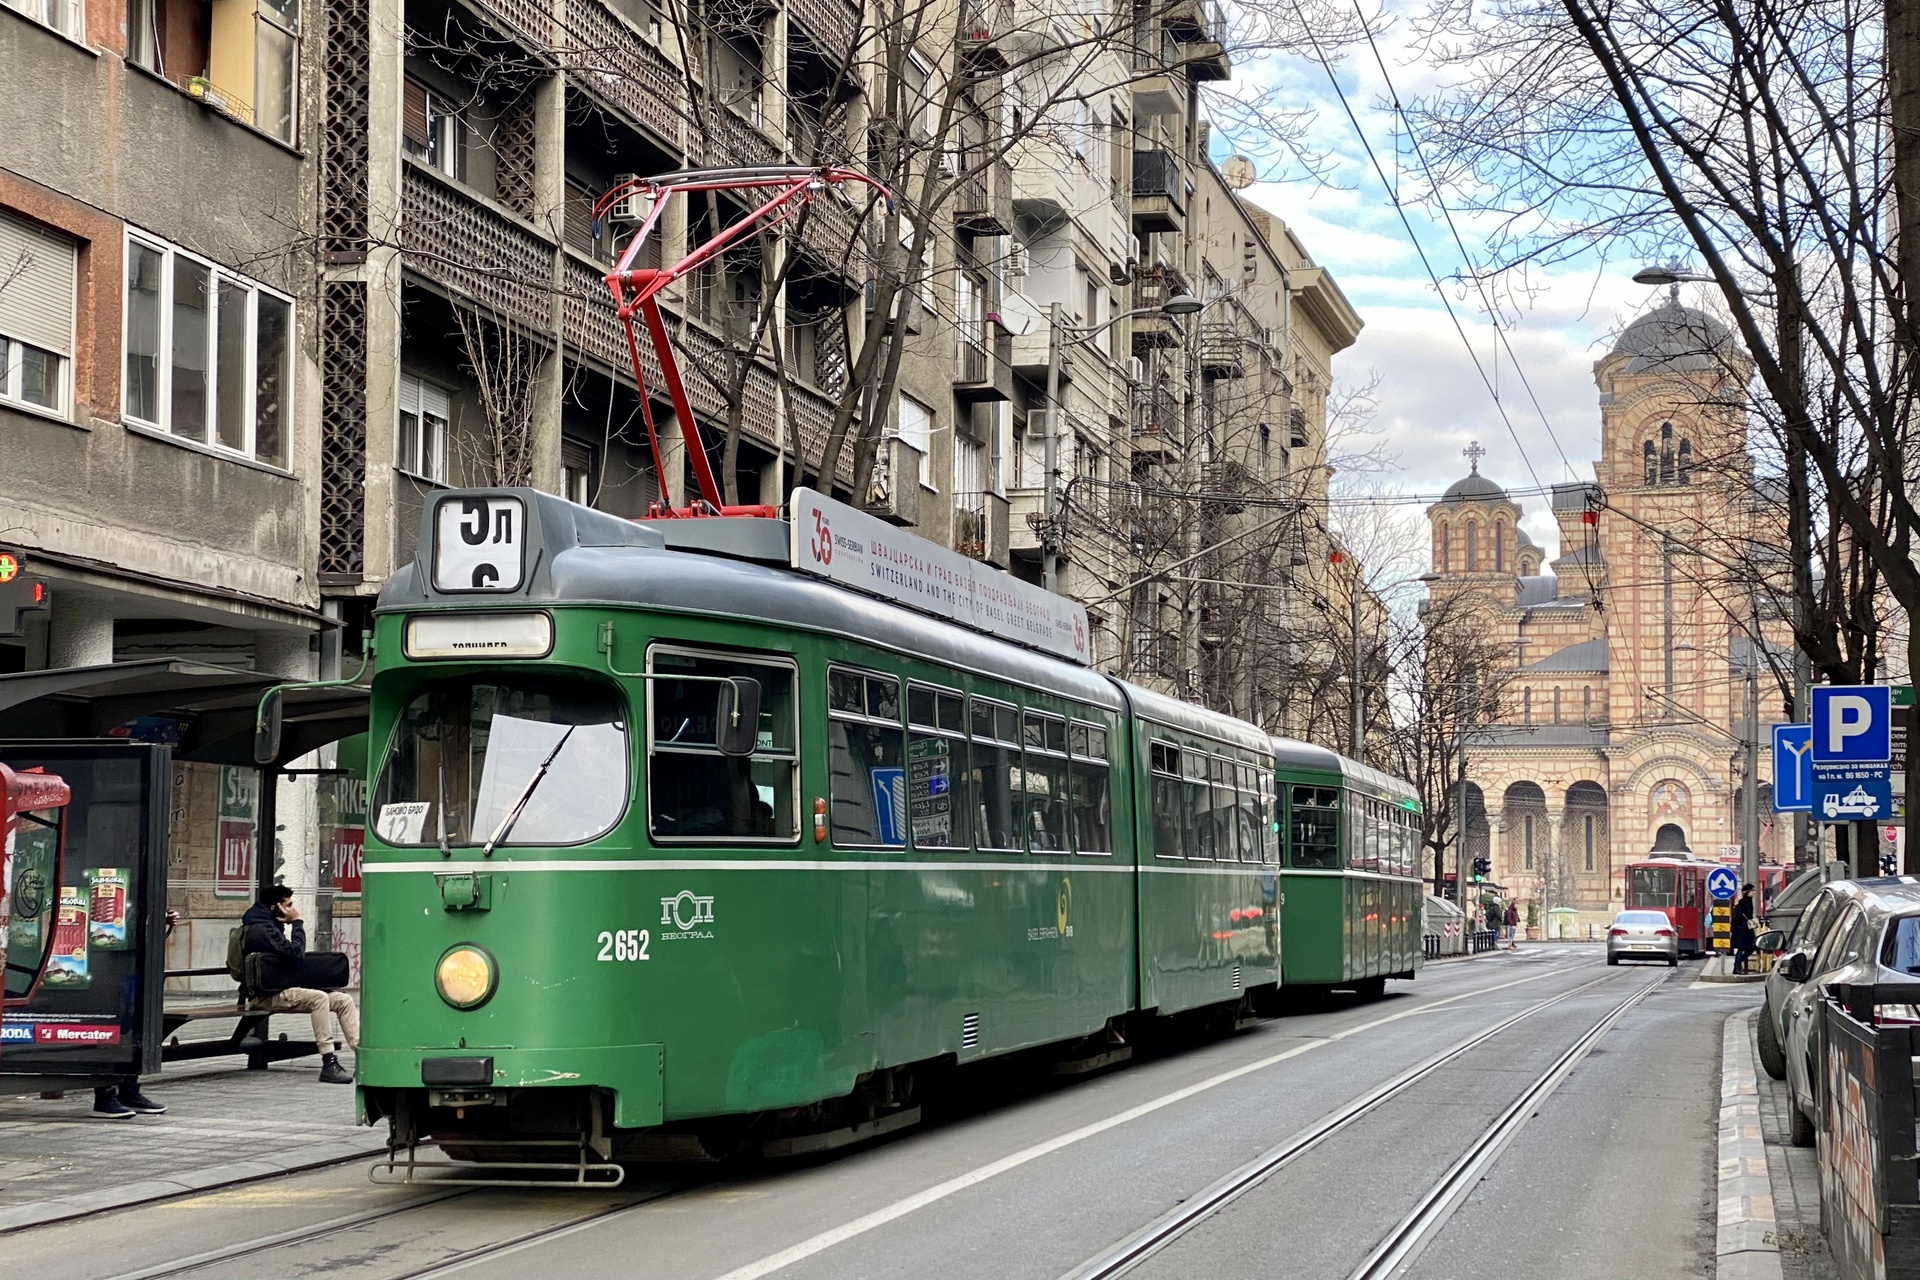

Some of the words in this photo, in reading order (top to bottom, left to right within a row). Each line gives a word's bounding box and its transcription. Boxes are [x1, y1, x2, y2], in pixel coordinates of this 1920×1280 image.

[870, 540, 923, 573] ШВАЈЦАРСКА
[927, 562, 931, 576] И
[934, 565, 952, 586] ГРАД
[1026, 601, 1051, 621] БЕОГРАД
[871, 562, 923, 593] SWITZERLAND
[926, 583, 940, 599] AND
[943, 589, 956, 605] THE
[959, 594, 973, 611] CITY
[976, 601, 984, 613] OF
[986, 605, 1004, 622] BASEL
[1006, 612, 1024, 629] GREET
[1026, 619, 1053, 639] BELGRADE
[1829, 695, 1872, 752] P
[1813, 763, 1850, 771] Резервисано
[385, 806, 407, 816] БАНОВО
[408, 805, 424, 815] БРДО
[388, 815, 409, 844] 12
[661, 890, 714, 930] ГСП
[597, 929, 650, 961] 2652
[57, 1028, 113, 1040] Mercator
